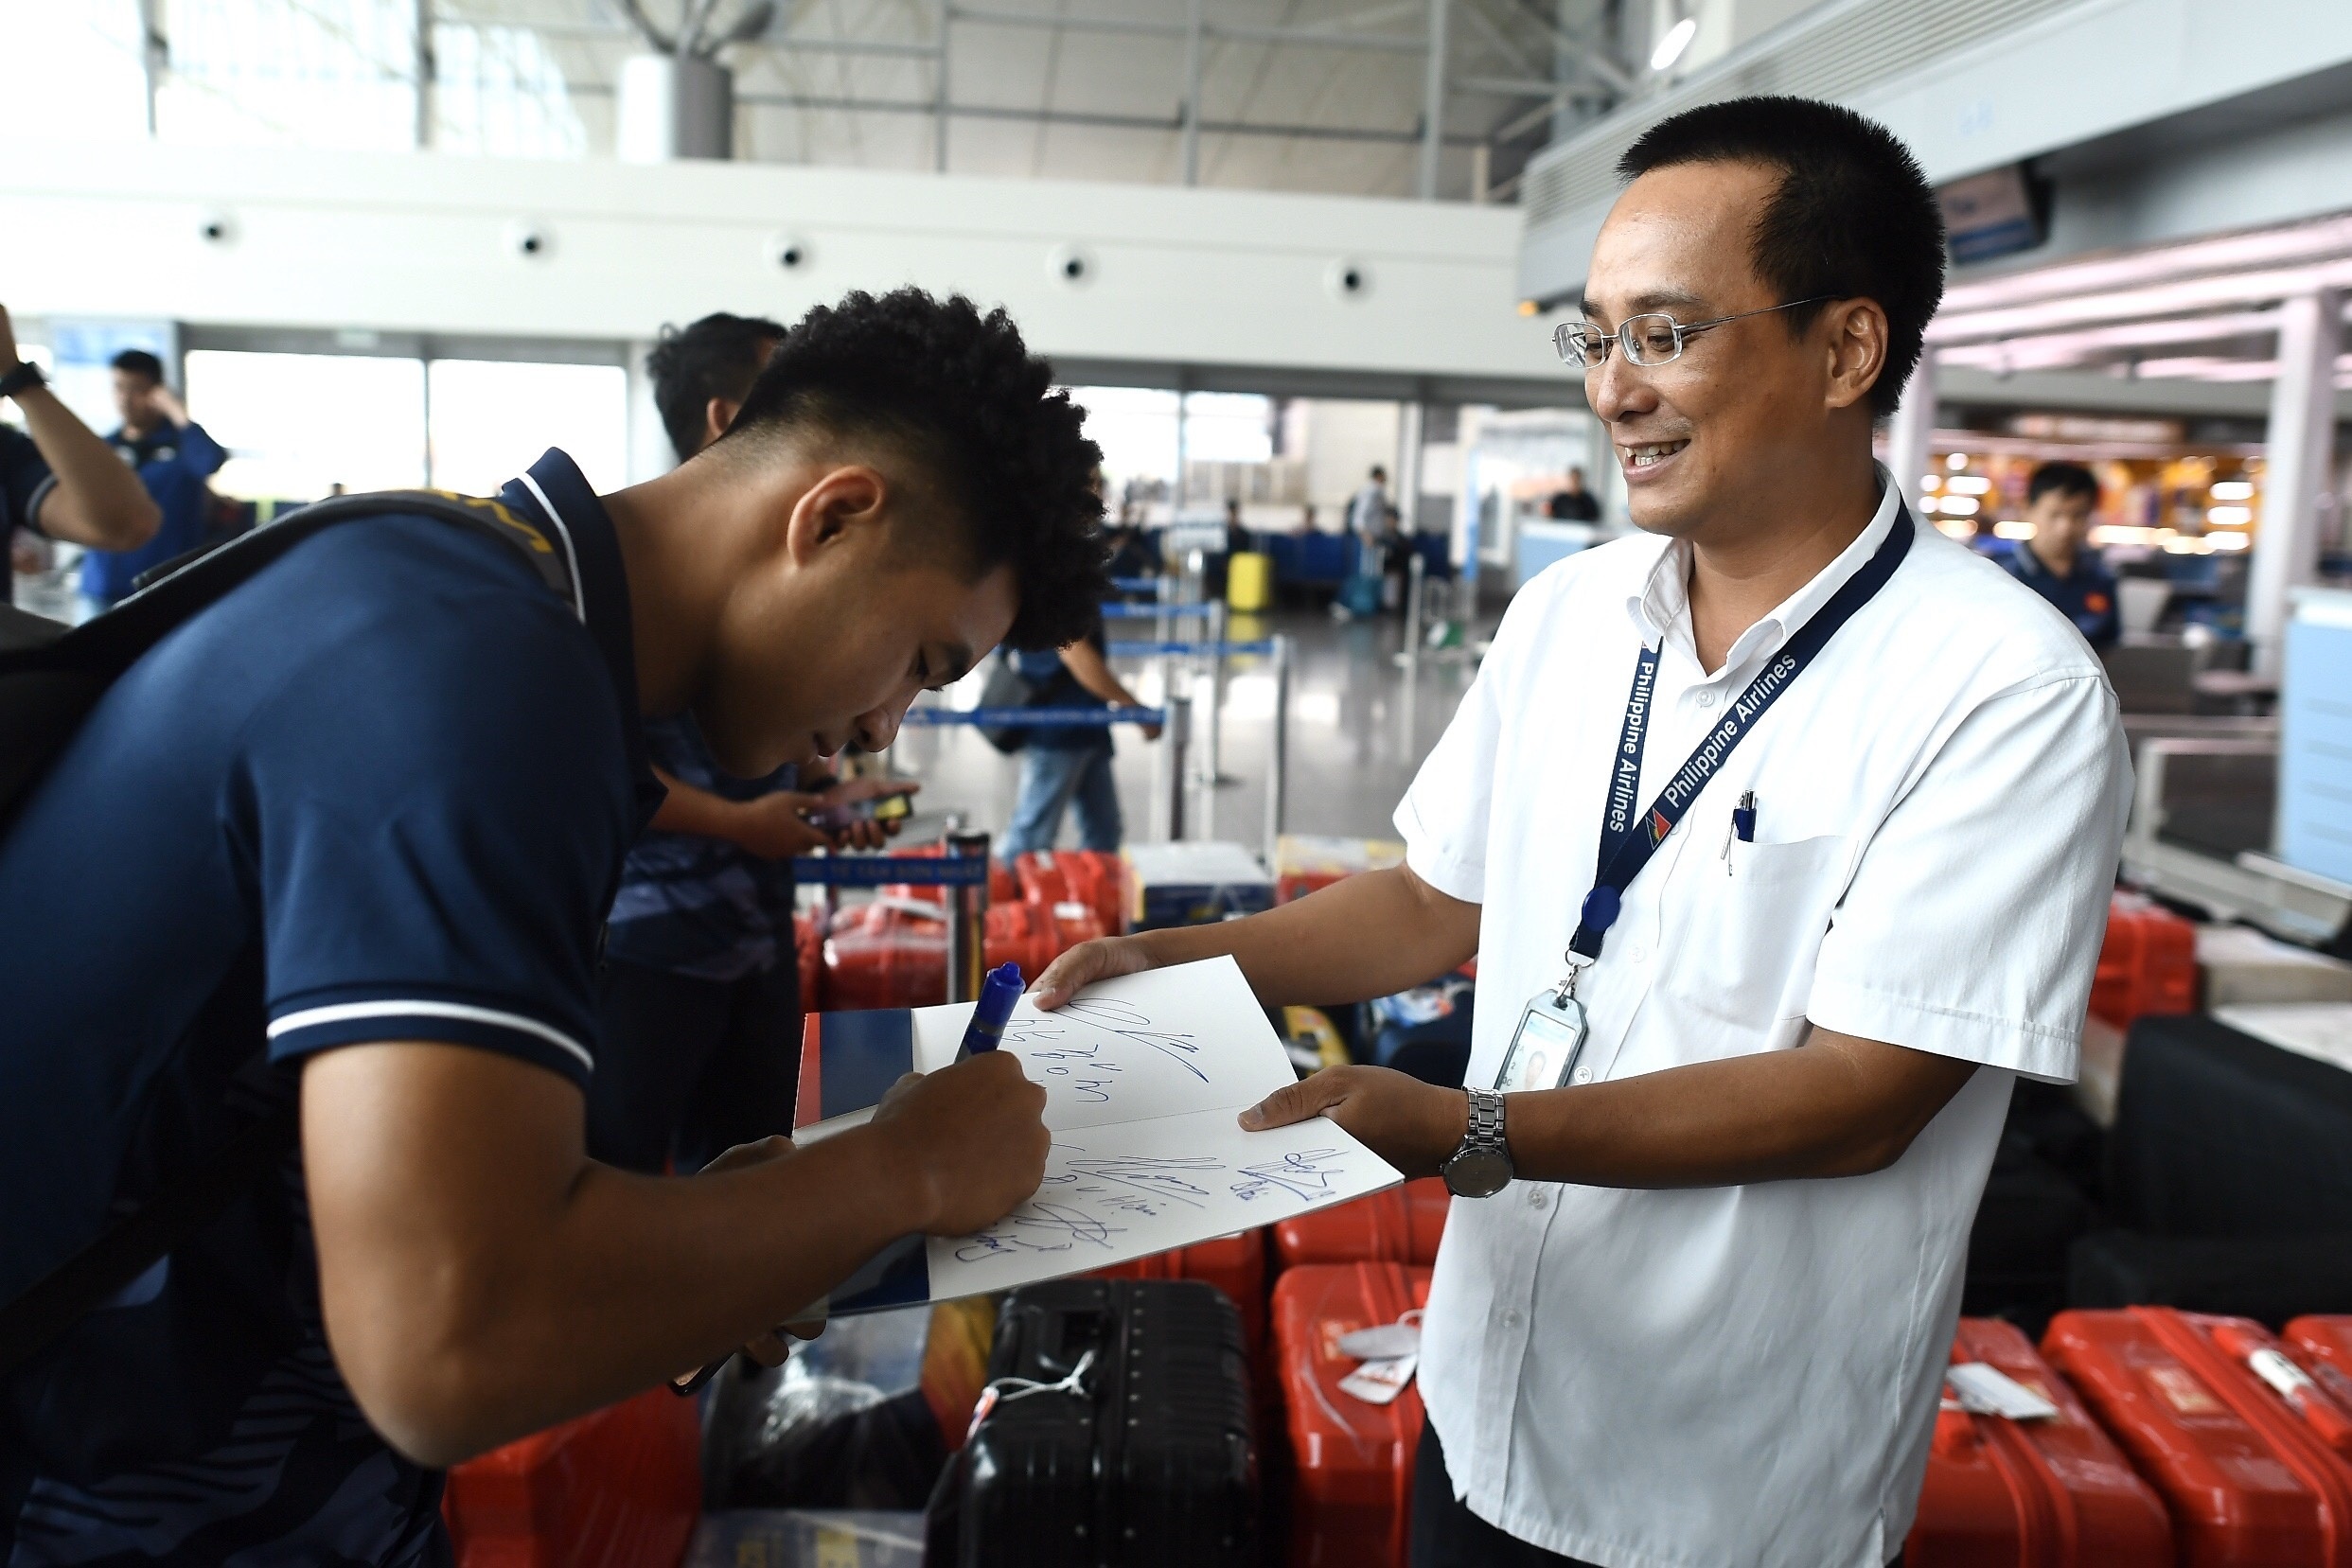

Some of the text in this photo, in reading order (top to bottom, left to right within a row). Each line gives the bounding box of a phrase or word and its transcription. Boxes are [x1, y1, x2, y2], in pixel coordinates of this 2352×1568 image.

[1610, 661, 1653, 833] Philippine Airlines
[1664, 654, 1795, 808] Philippine Airlines
